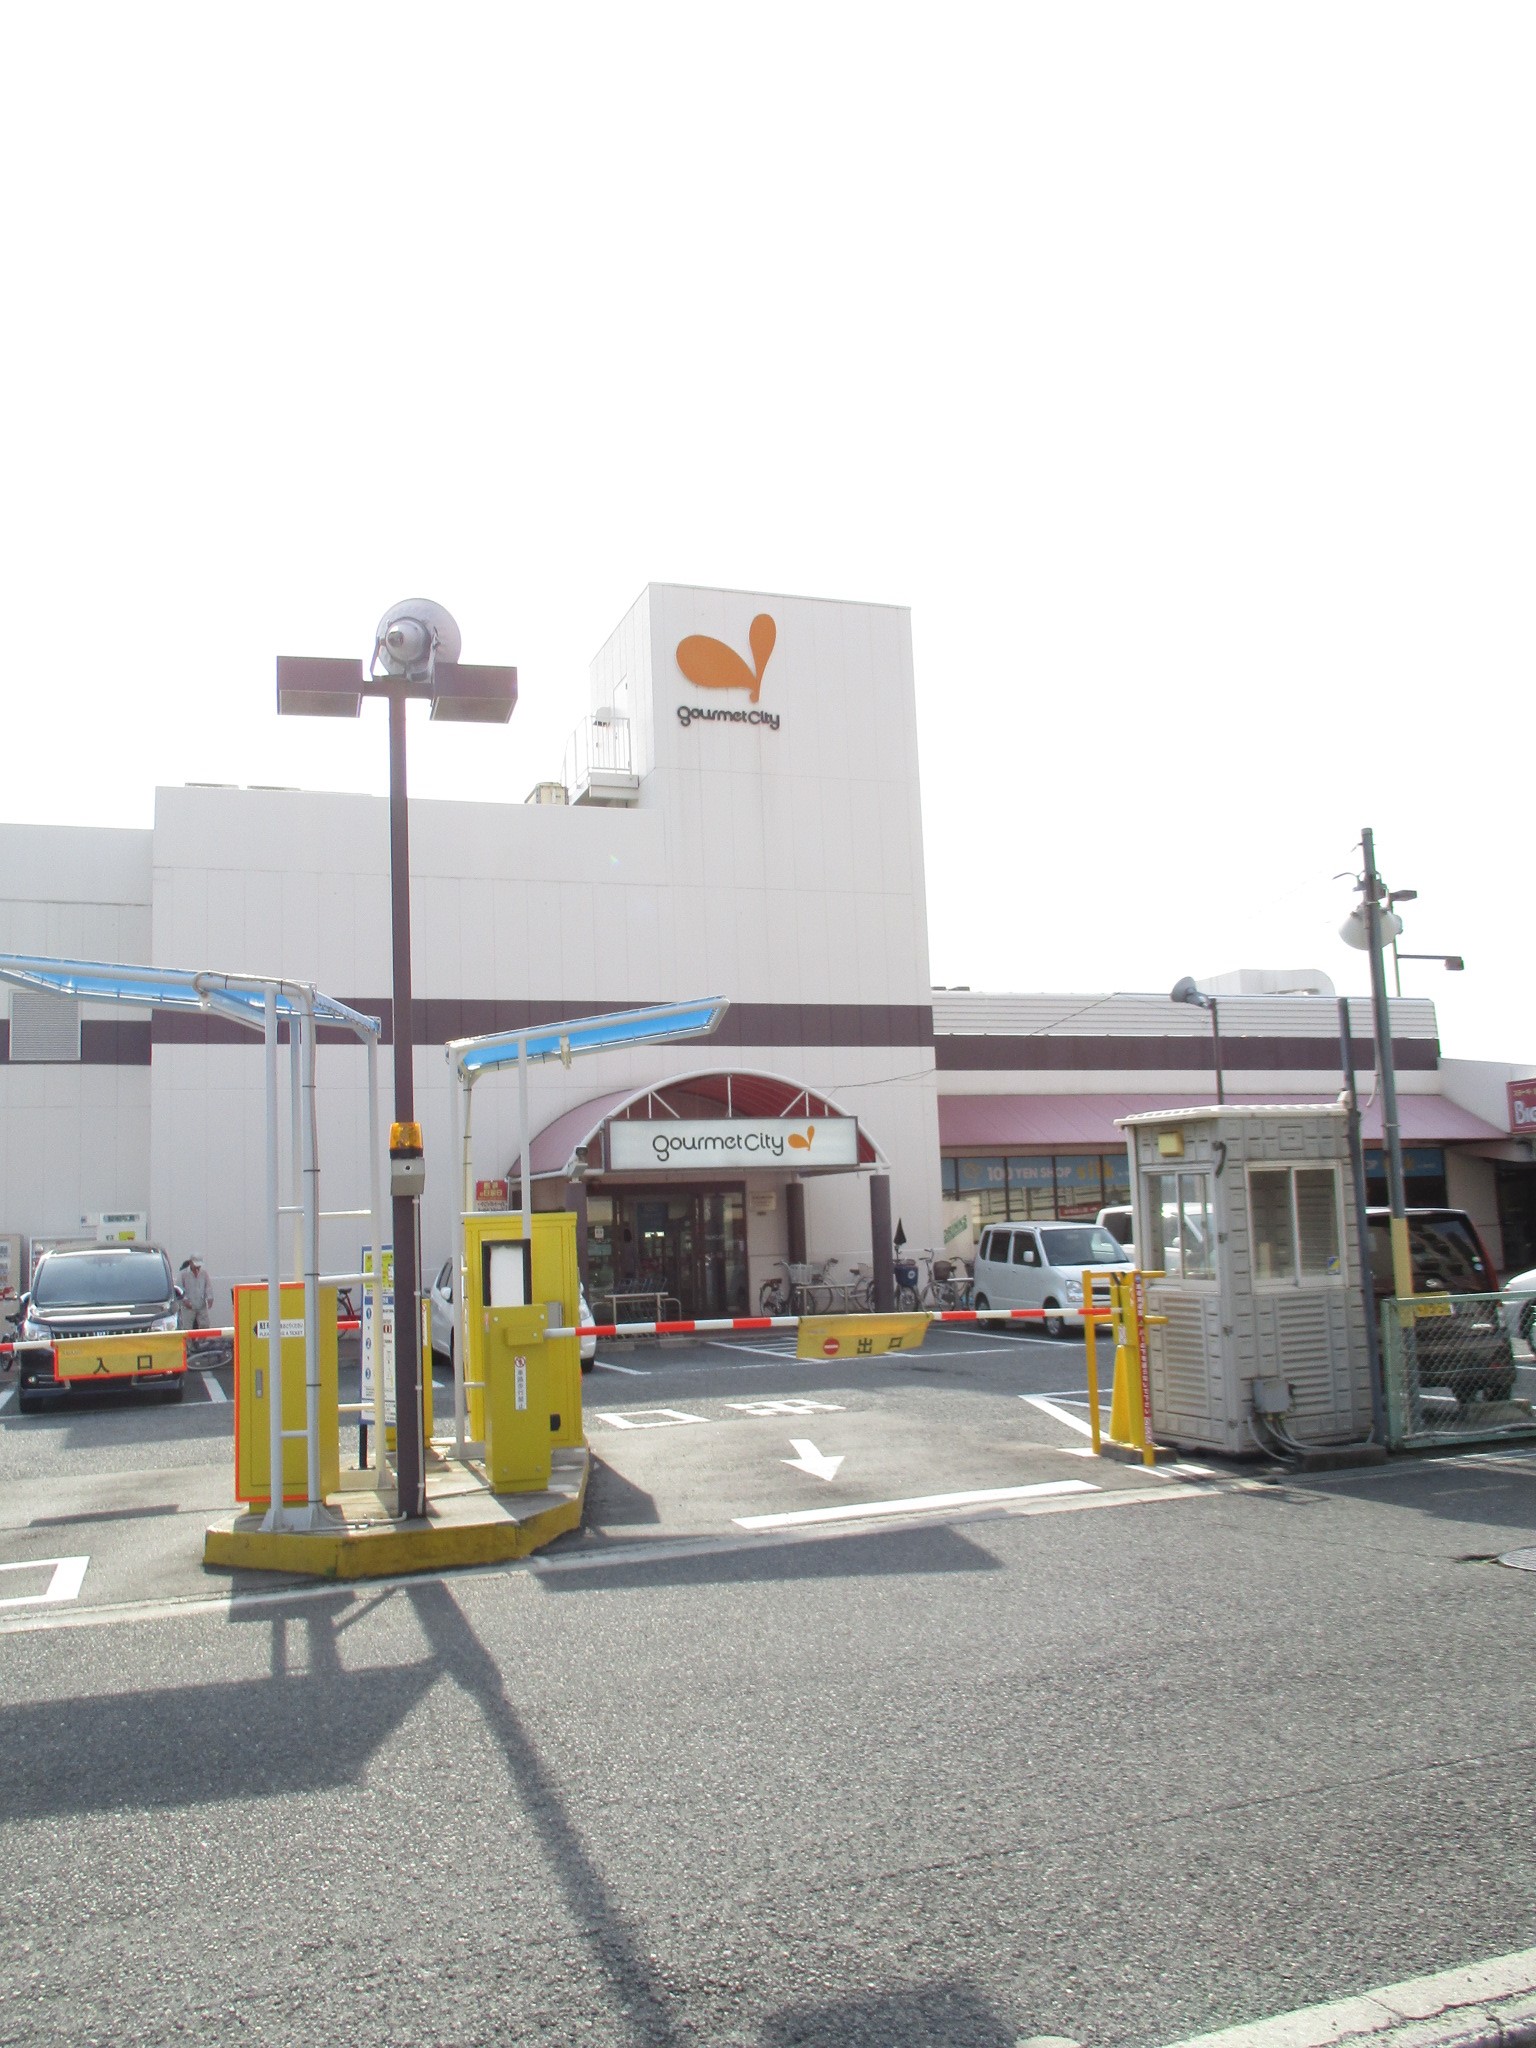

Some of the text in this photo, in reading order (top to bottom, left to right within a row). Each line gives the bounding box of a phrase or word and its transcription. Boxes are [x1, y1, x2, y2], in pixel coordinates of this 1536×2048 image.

[1015, 1167, 1038, 1179] YEN
[1040, 1165, 1072, 1178] SHOP
[857, 1337, 904, 1355] 出口
[93, 1355, 153, 1374] 入口
